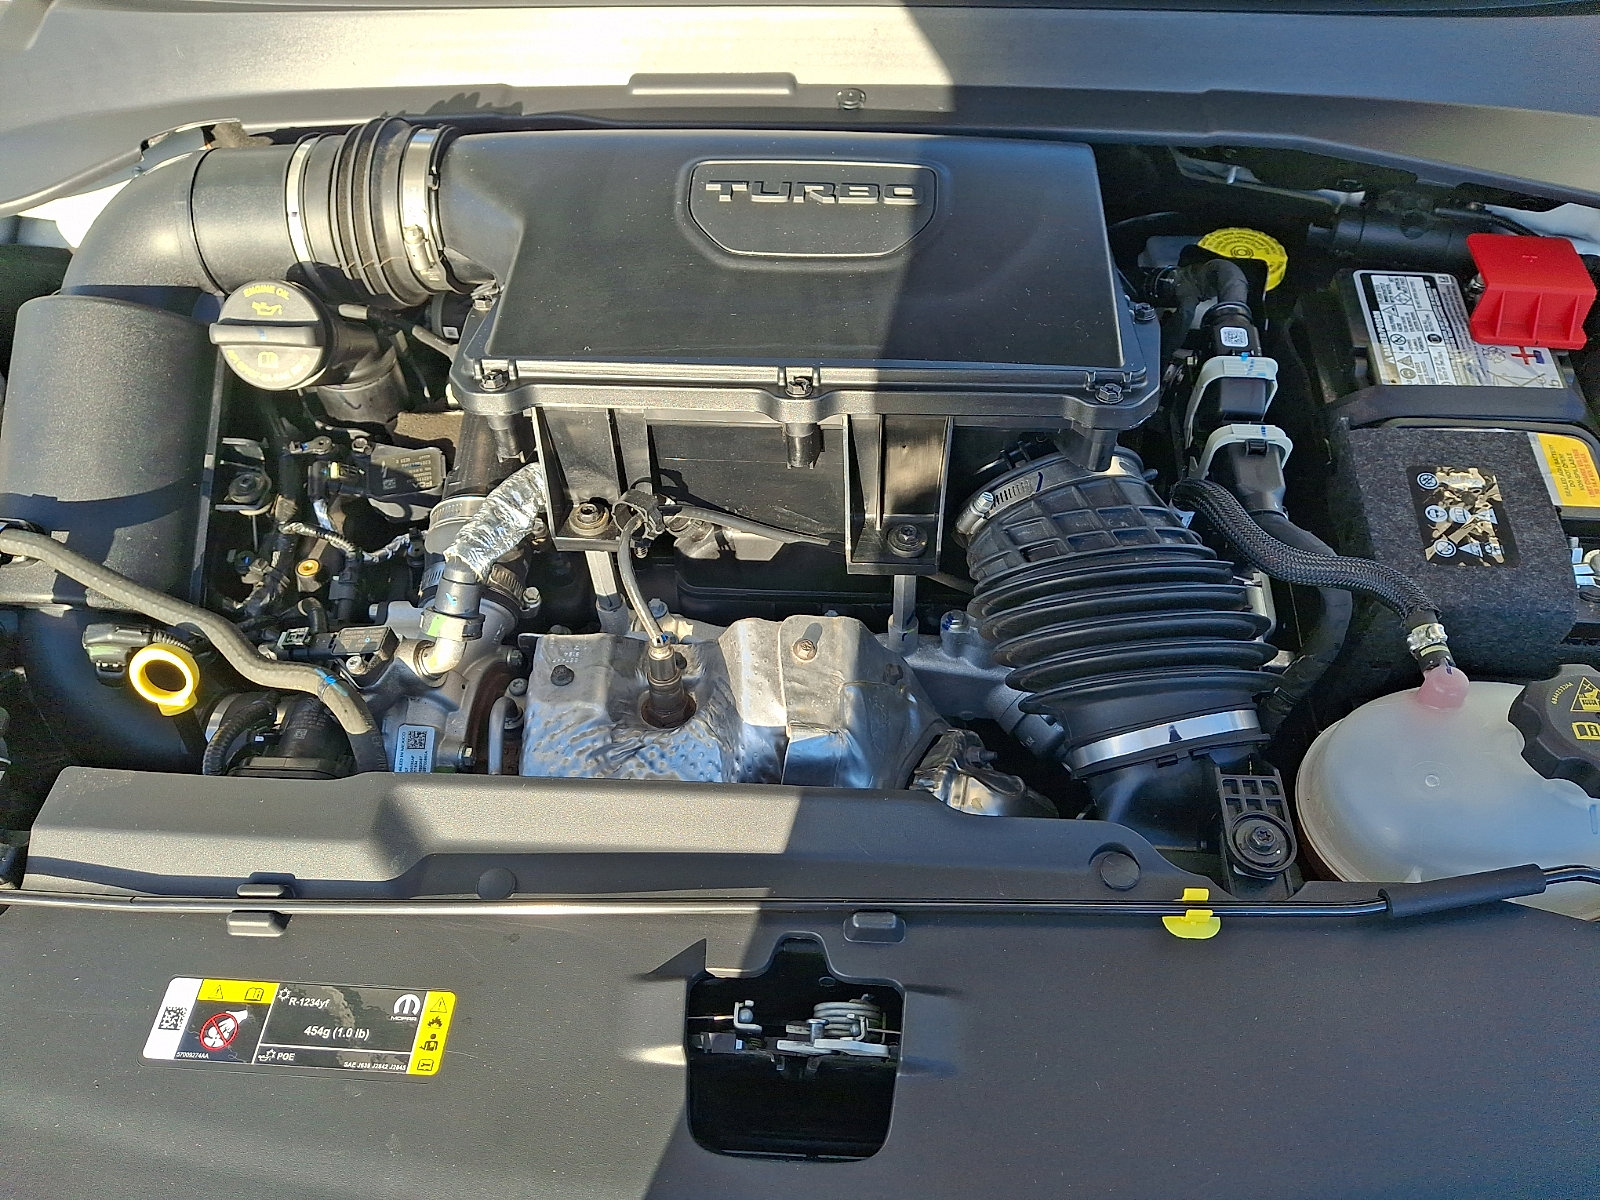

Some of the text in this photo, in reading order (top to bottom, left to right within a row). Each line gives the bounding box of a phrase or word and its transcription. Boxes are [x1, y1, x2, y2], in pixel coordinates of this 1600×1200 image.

[705, 180, 922, 205] TURBO
[243, 284, 290, 301] ENGINE OIL
[288, 996, 331, 1009] R-1234yf
[303, 1025, 370, 1041] 454g (1.0 lb)
[277, 1052, 295, 1061] POE
